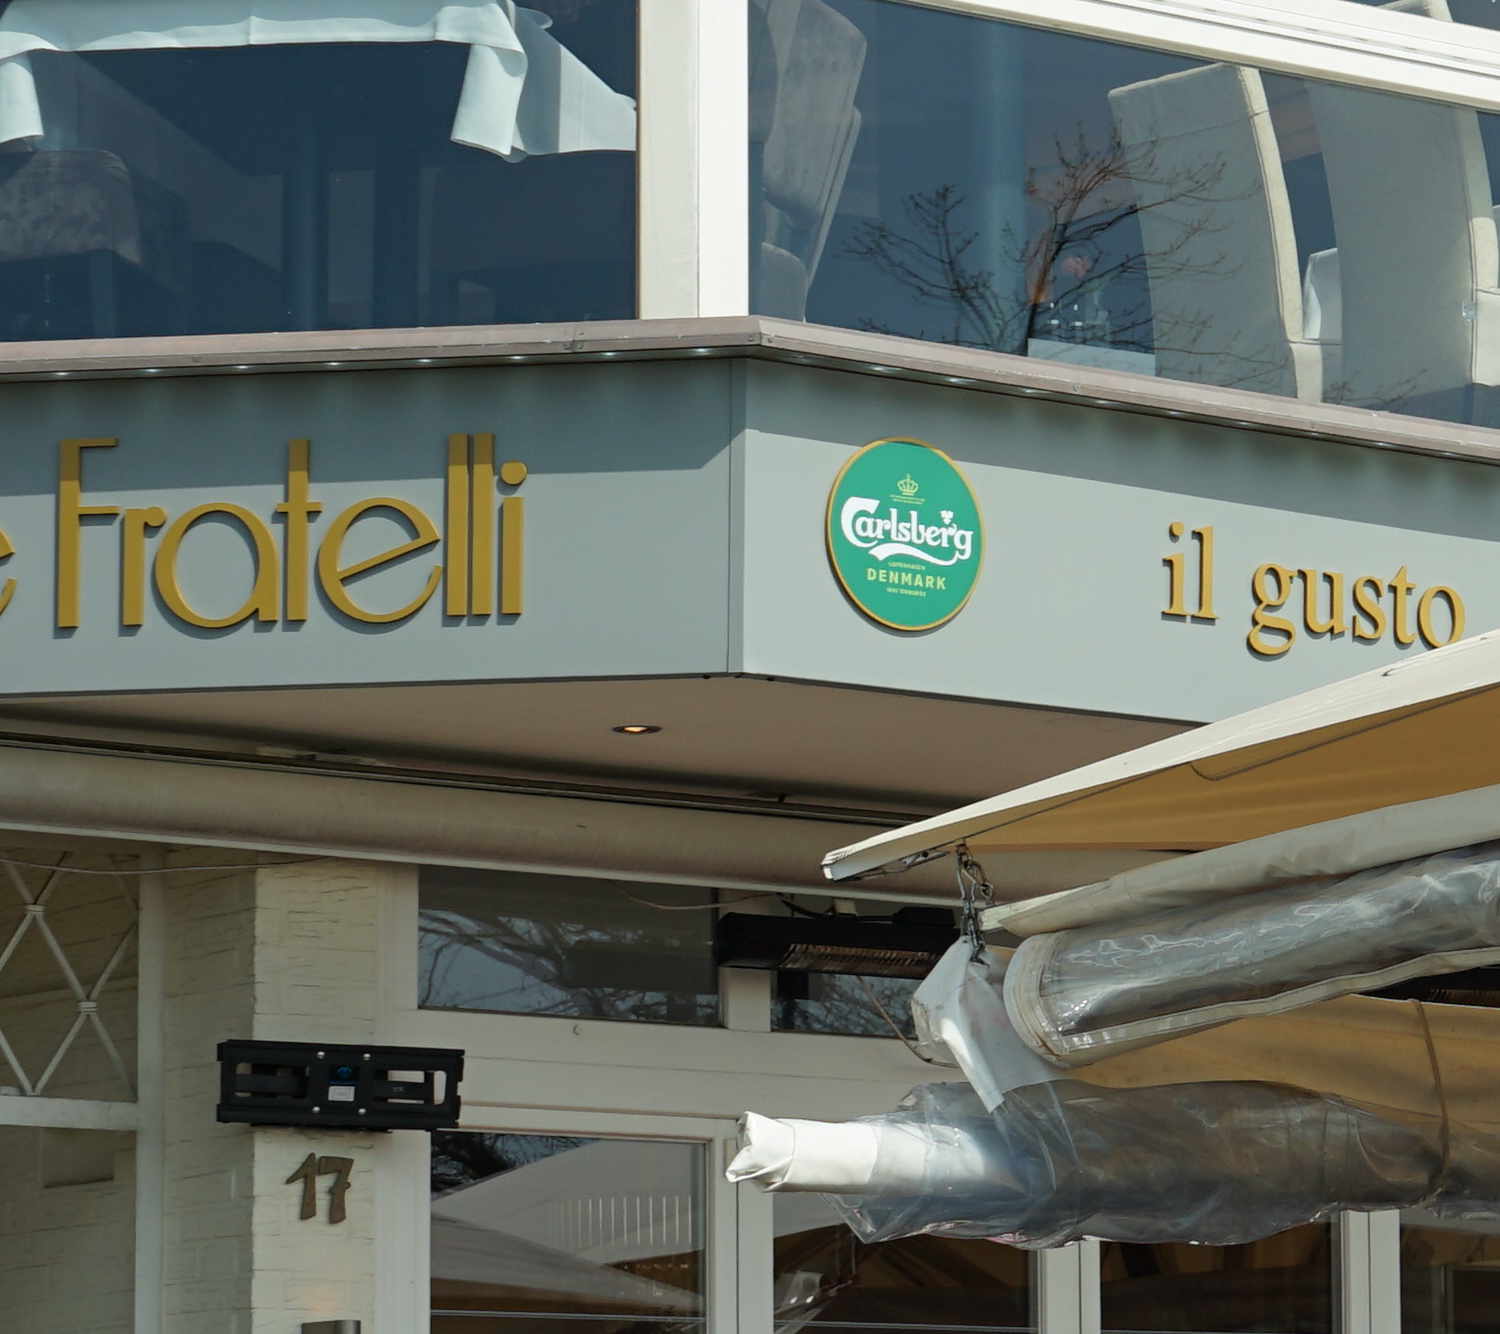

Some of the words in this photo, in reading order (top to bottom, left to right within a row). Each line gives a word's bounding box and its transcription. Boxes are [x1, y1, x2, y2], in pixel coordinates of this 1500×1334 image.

[57, 433, 528, 629] Fratelli
[840, 496, 975, 563] Carlsberg
[866, 567, 948, 591] DENMARK
[1161, 521, 1220, 621] il
[1247, 563, 1466, 656] gusto
[284, 1151, 355, 1225] 17
